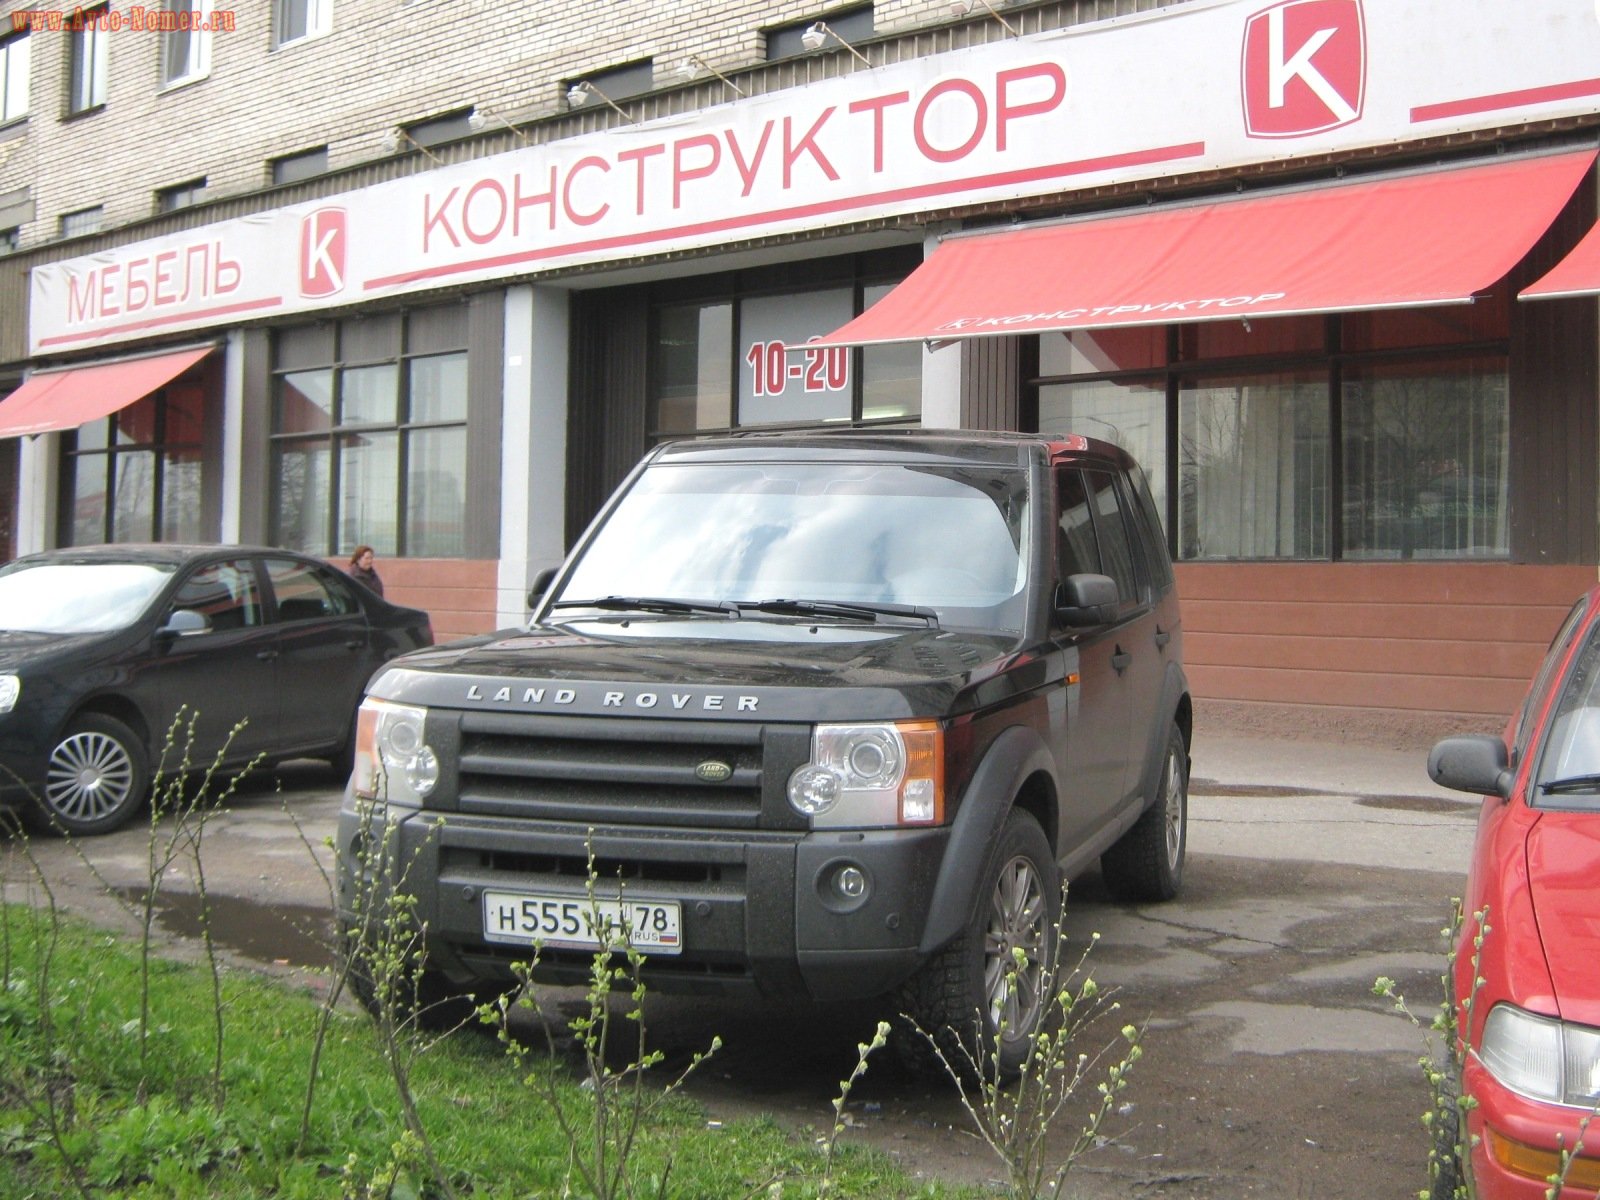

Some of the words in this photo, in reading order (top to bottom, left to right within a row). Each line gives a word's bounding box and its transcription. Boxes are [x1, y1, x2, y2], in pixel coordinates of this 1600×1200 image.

[67, 240, 241, 324] МЕБЕЛЬ
[423, 63, 1065, 254] КОНСТРУКТОР
[976, 292, 1286, 327] КОНСТРУКТОР
[746, 335, 848, 397] 10-20
[466, 685, 577, 704] LAND
[603, 691, 760, 712] ROVER
[635, 907, 668, 932] 78
[634, 932, 658, 942] RUS
